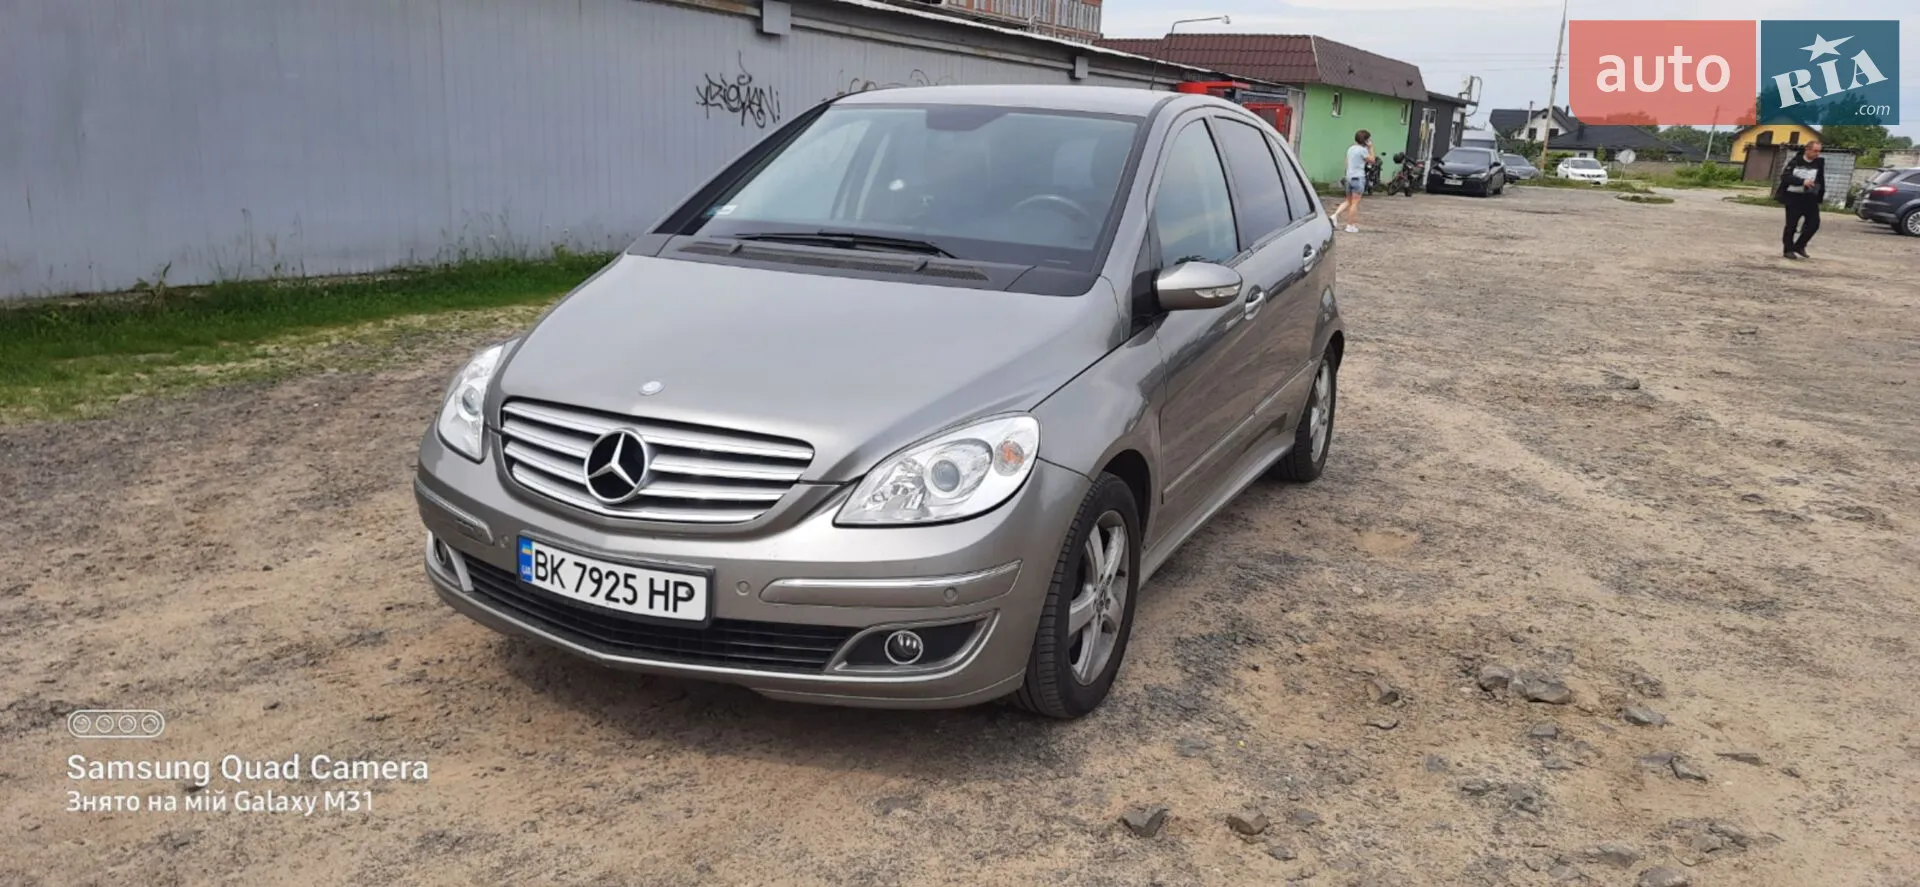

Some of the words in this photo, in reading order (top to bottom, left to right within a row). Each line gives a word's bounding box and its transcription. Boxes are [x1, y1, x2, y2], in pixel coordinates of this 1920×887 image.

[534, 549, 566, 589] BK
[573, 561, 638, 606] 7925
[648, 577, 696, 613] HP
